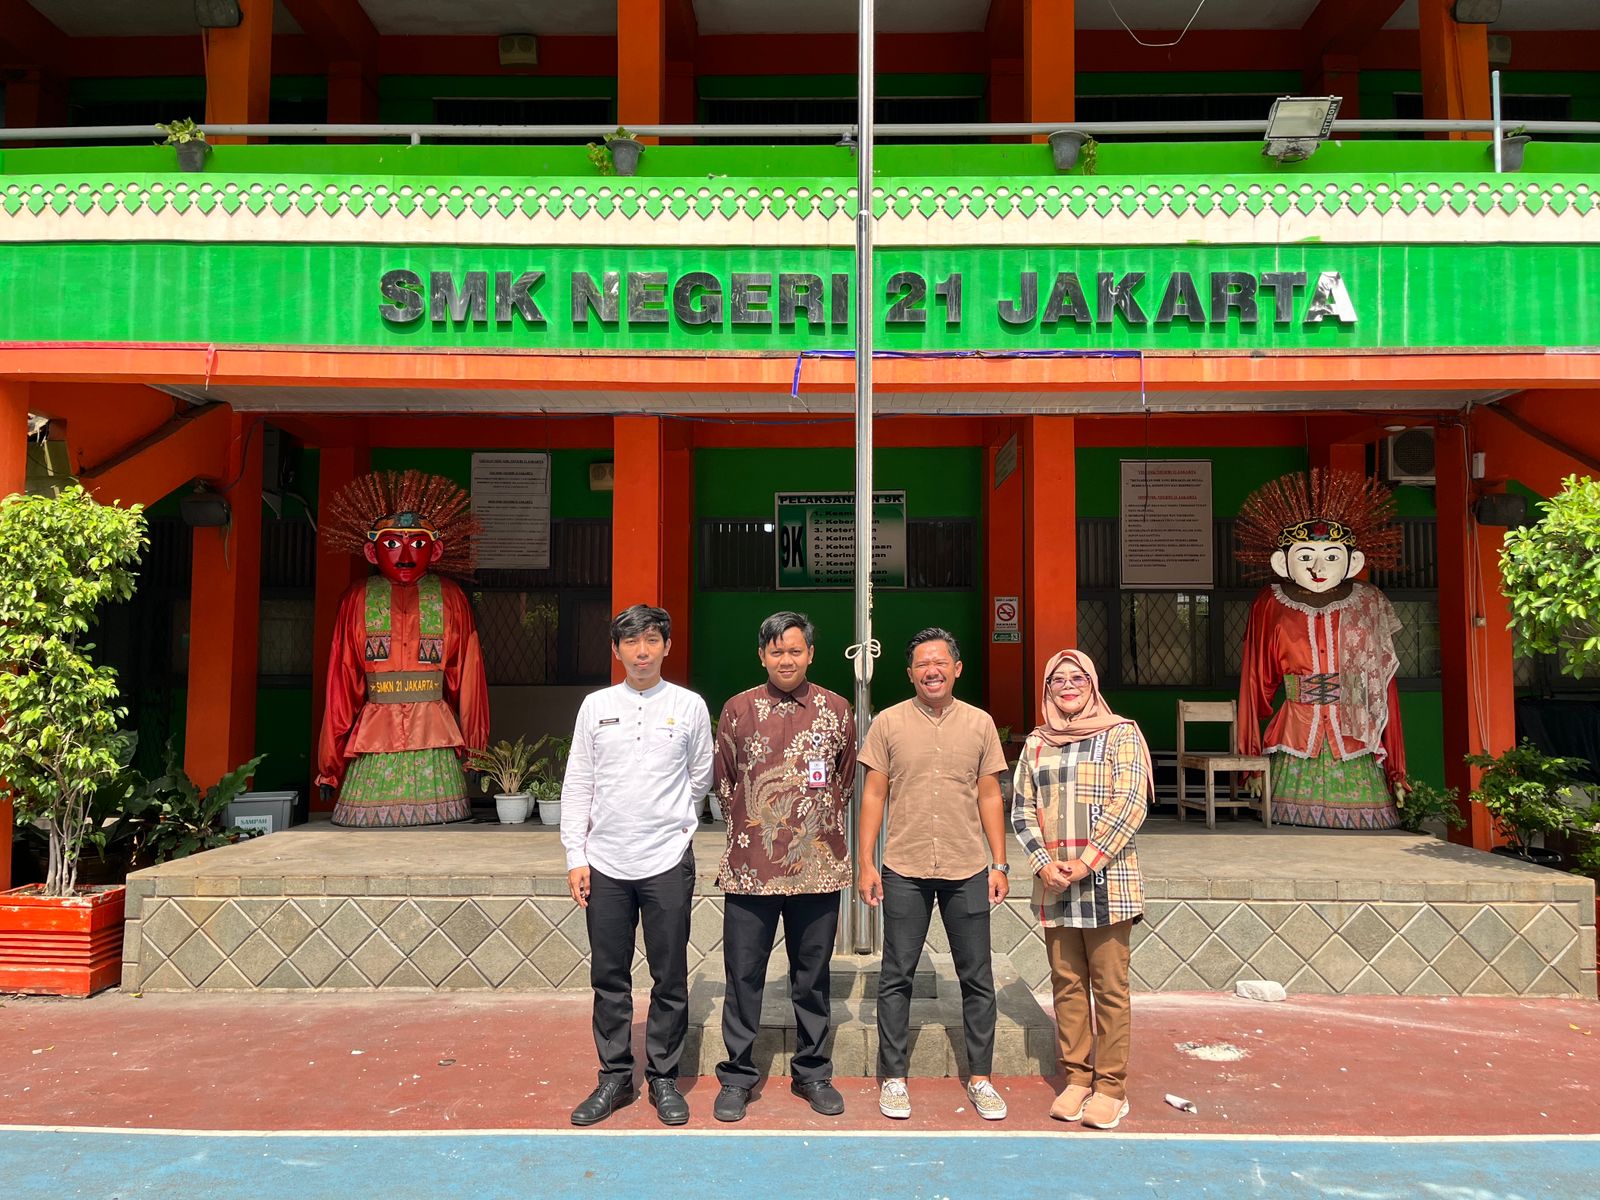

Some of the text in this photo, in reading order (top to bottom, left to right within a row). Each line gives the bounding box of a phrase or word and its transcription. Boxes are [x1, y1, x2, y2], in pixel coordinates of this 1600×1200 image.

[1321, 103, 1338, 134] CITISON
[378, 269, 1359, 325] SMK NEGERI 21 JAKARTA
[780, 494, 903, 504] PELAKSANN 9K
[781, 525, 804, 568] 9K
[376, 680, 434, 693] SMKN 21 JAKARTA
